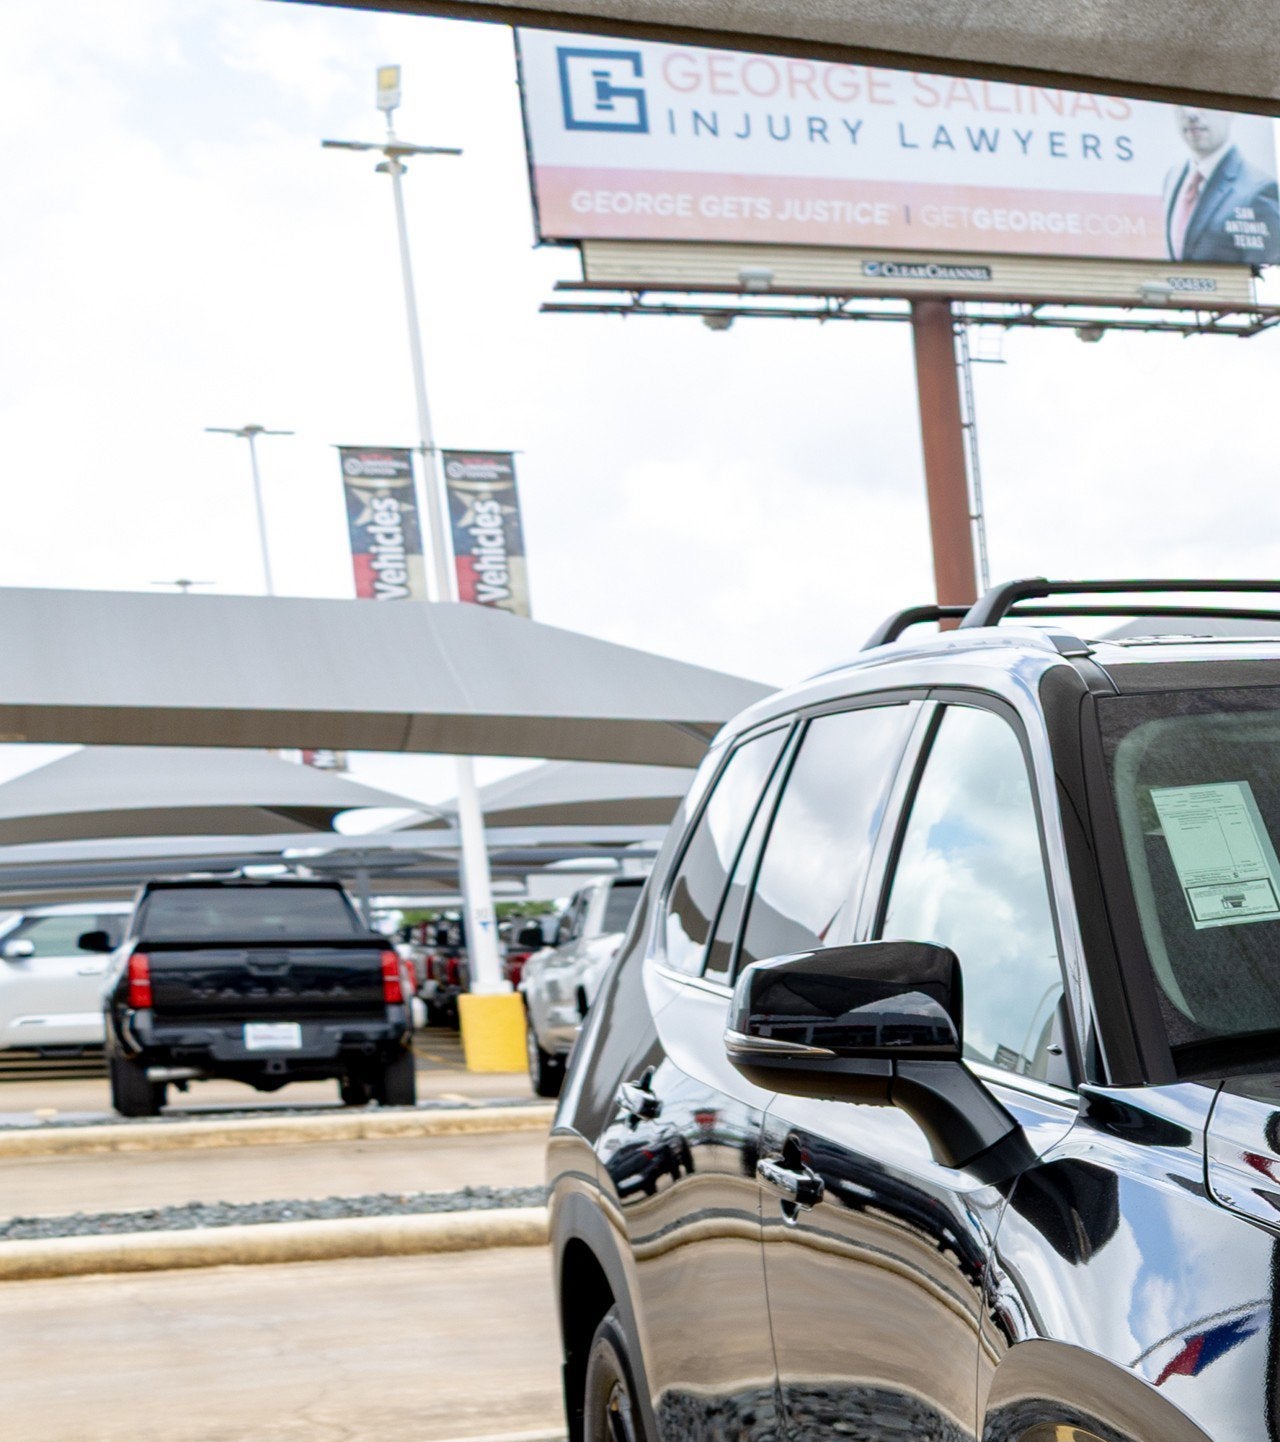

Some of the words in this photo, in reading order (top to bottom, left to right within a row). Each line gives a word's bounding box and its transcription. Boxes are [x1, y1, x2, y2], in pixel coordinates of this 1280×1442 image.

[662, 51, 895, 105] GEORGE
[912, 72, 1134, 121] SALINAS
[667, 108, 866, 144] INJURY
[898, 122, 1135, 161] LAWYERS
[571, 190, 692, 218] GEORGE
[699, 195, 771, 219] GETS
[775, 200, 890, 226] JUSTICE
[367, 497, 410, 600] Vehicles
[469, 500, 510, 603] Vehicles
